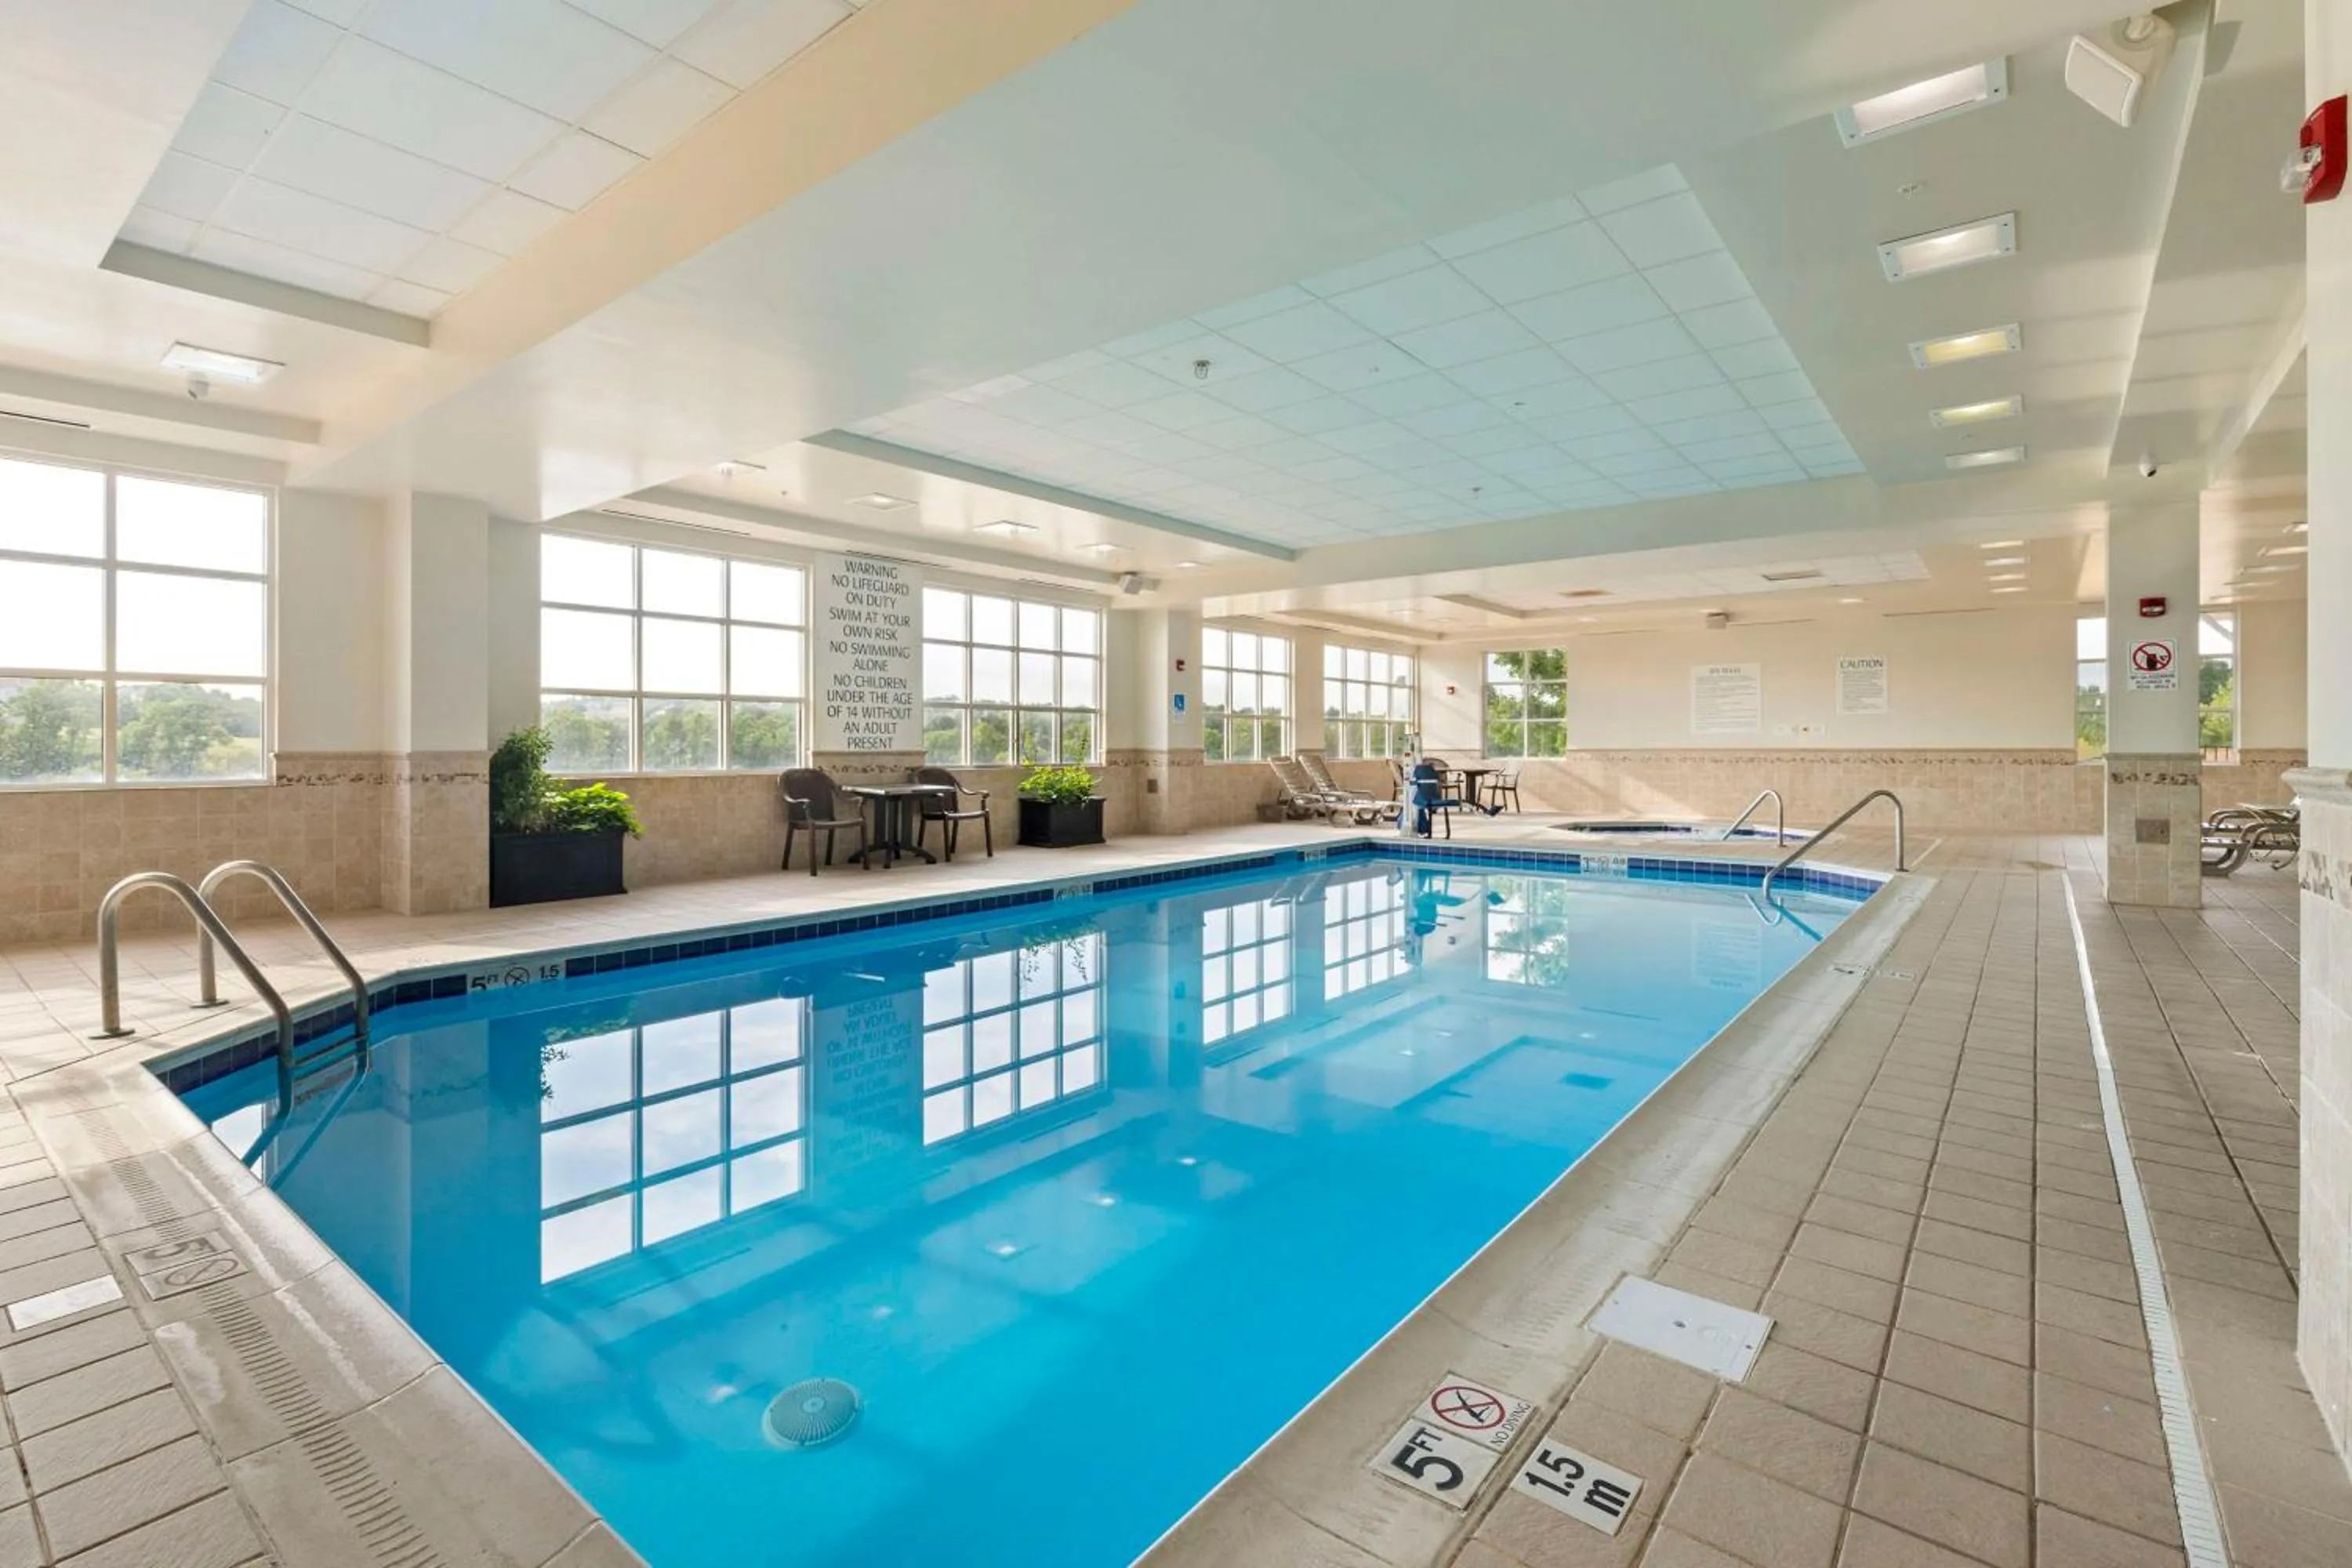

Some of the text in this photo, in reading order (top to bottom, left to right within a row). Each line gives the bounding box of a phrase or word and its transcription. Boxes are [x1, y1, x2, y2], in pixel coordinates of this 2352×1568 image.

[844, 559, 898, 579] WARNING
[832, 574, 909, 597] NO LIFEGUARD
[846, 591, 898, 609] ON DUTY
[829, 607, 910, 628] SWIM AT YOUR
[843, 625, 898, 641] OWN RISK
[829, 640, 911, 660] NO SWIMMING
[852, 659, 889, 672] ALONE
[1840, 659, 1884, 670] CAUTION
[833, 673, 907, 689] NO CHILDREN
[827, 690, 914, 706] UNDER THE AGE
[827, 706, 913, 720] OF 14 WITHOUT
[843, 721, 898, 735] AN ADULT
[848, 736, 894, 750] PRESENT
[1490, 1401, 1532, 1446] NO DIVING
[1525, 1449, 1584, 1497] 1.5
[1583, 1479, 1632, 1517] m
